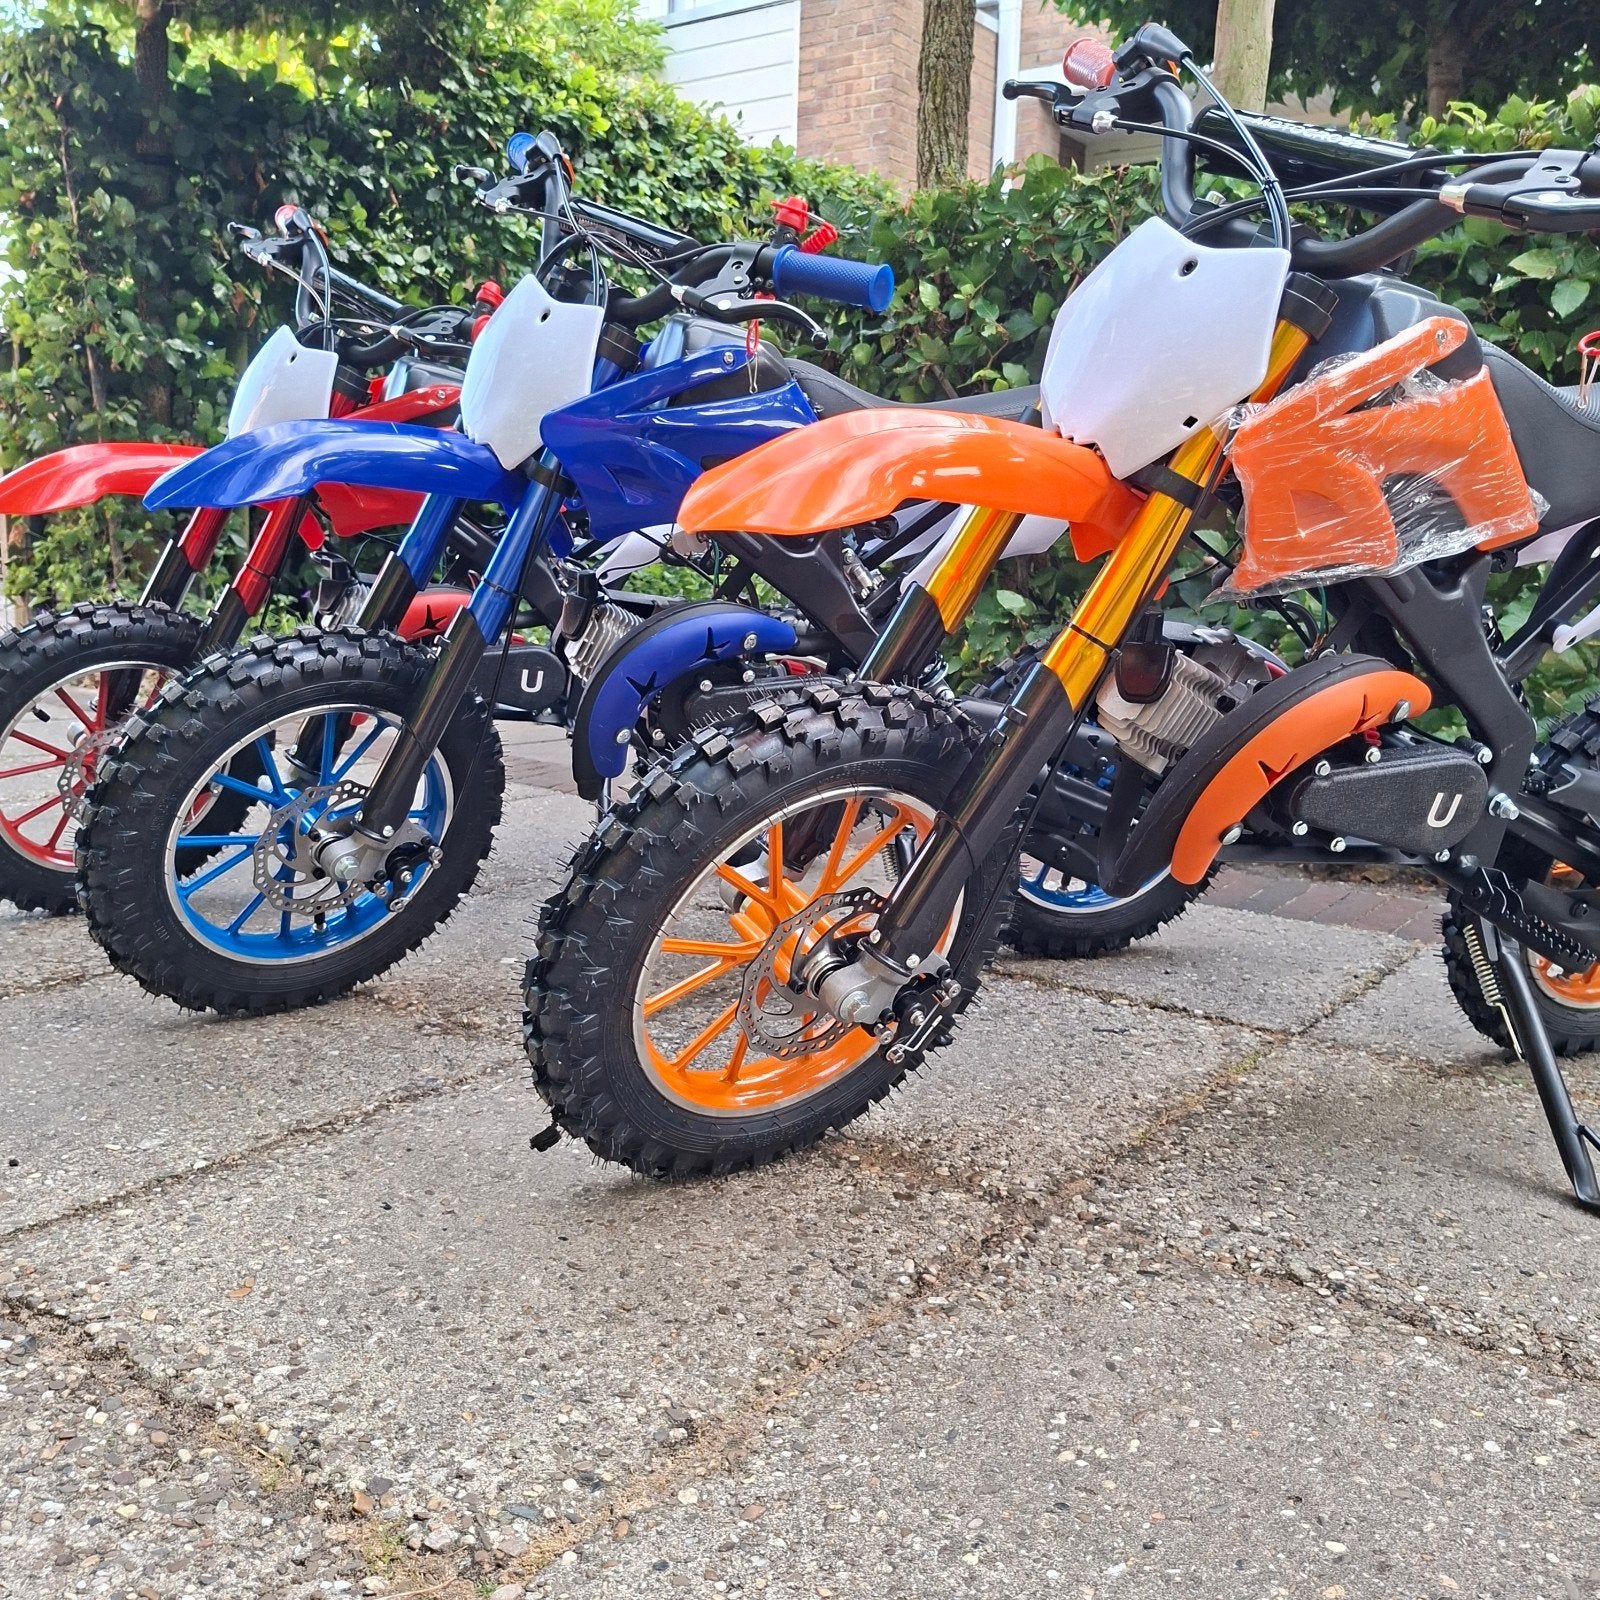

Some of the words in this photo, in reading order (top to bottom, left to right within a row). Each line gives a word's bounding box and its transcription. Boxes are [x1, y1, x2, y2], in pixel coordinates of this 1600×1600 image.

[1254, 116, 1369, 149] MOTOCROSS
[521, 669, 544, 693] U
[1427, 792, 1463, 828] U
